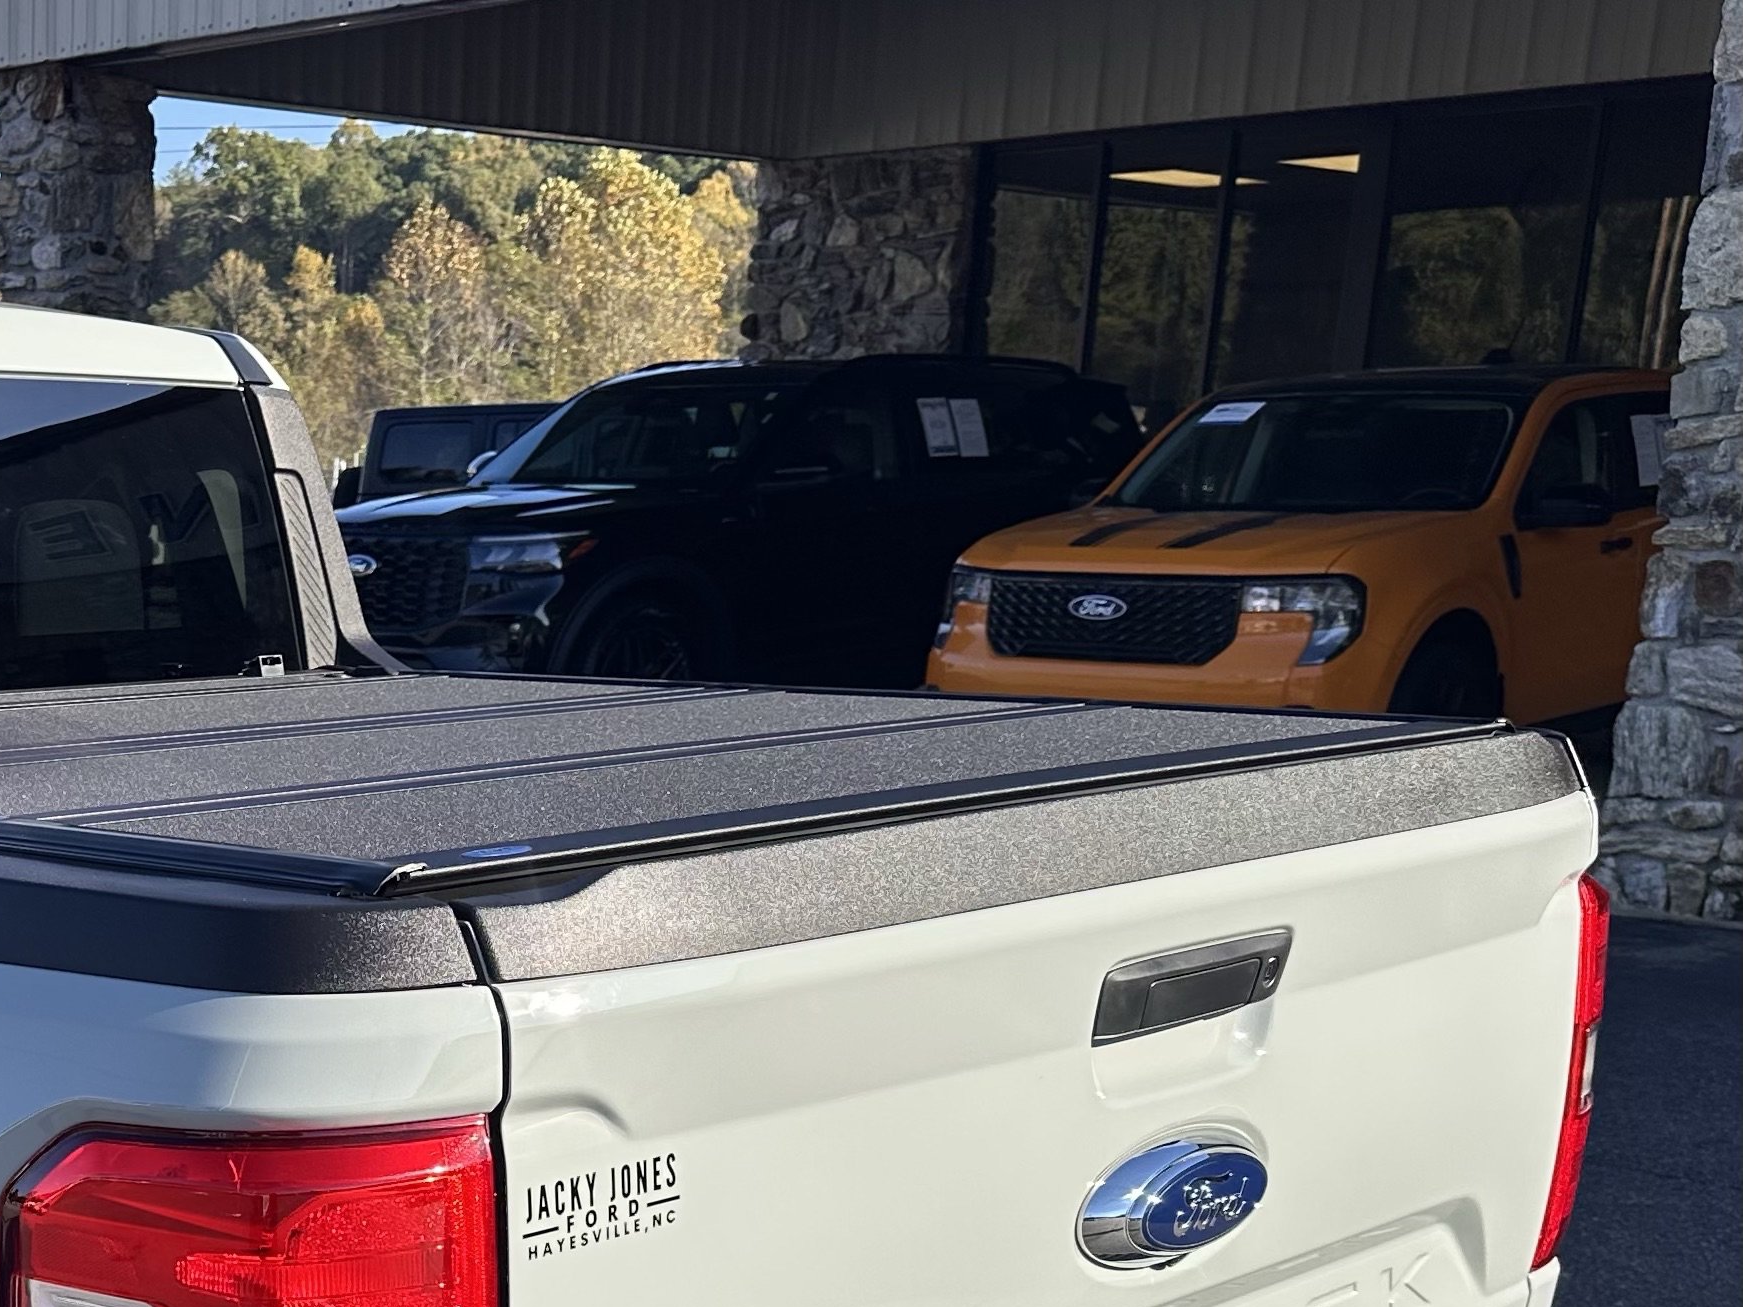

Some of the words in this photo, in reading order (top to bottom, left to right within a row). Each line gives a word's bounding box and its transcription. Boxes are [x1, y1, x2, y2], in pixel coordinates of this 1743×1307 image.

[526, 1171, 597, 1225] JACKY
[610, 1152, 677, 1203] JONES
[566, 1198, 640, 1234] FORD
